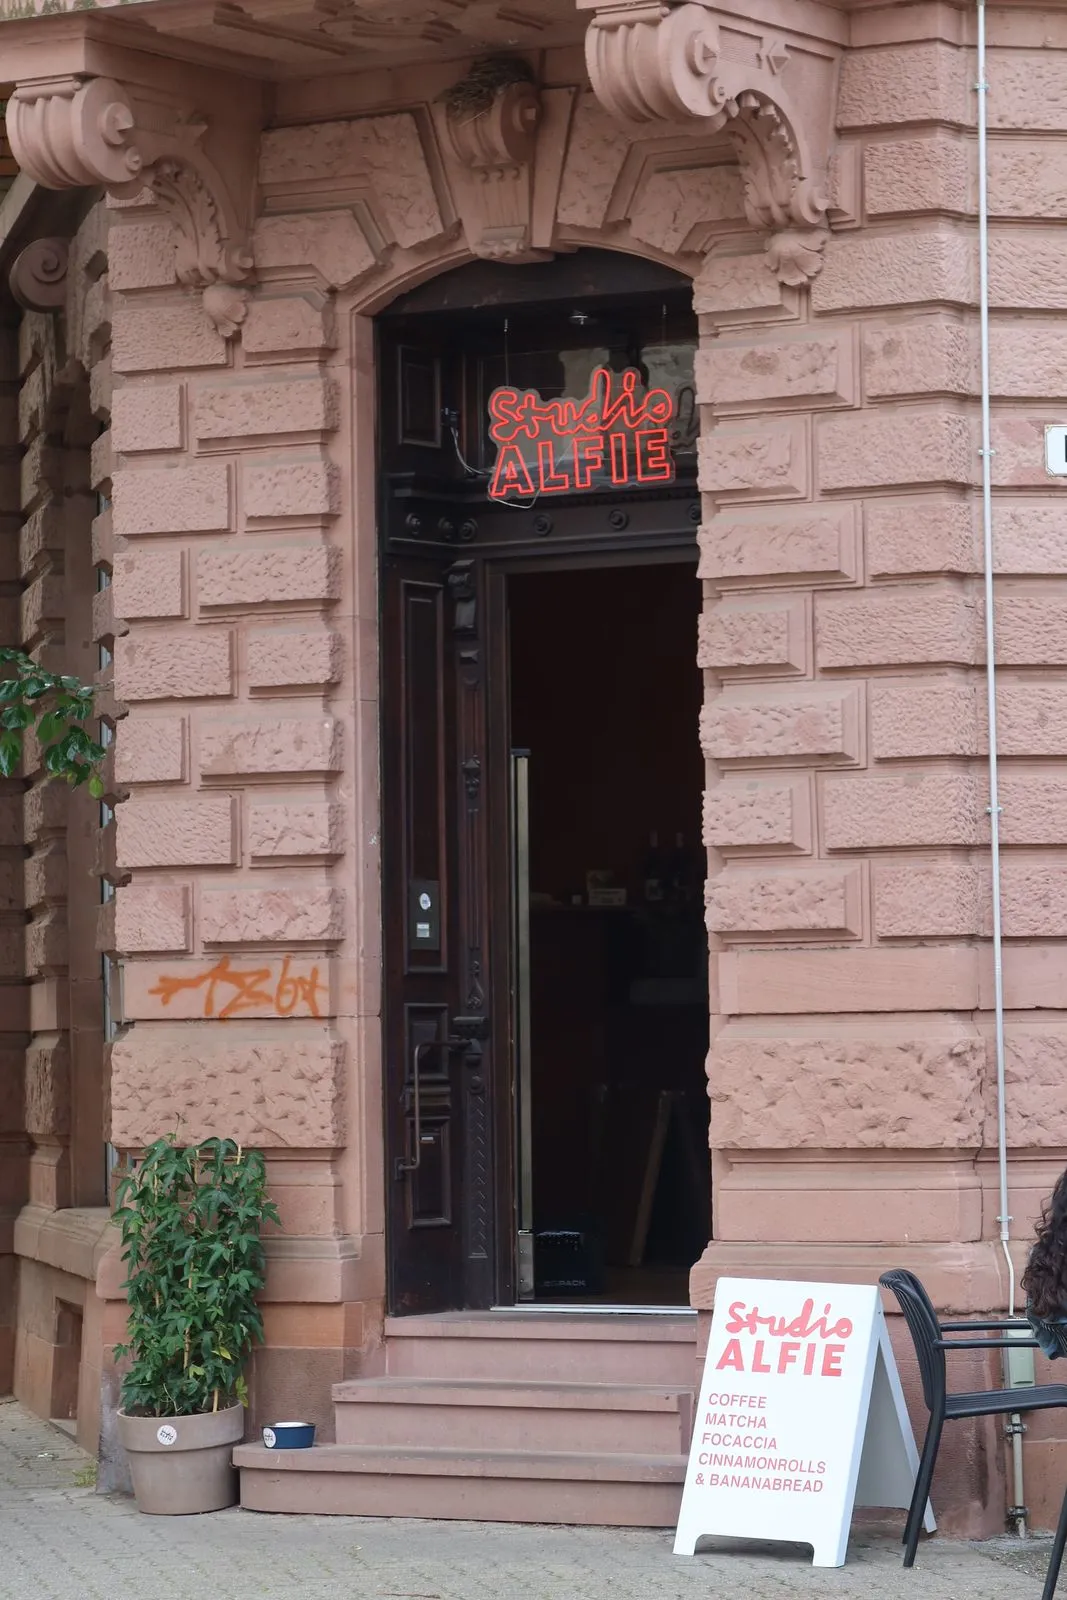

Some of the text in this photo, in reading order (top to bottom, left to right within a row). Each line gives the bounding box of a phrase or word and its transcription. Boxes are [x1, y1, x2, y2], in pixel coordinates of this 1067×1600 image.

[489, 368, 674, 442] Studio
[488, 428, 671, 498] ALFIE
[725, 1298, 853, 1339] Studio
[715, 1338, 846, 1378] ALFIE
[708, 1393, 768, 1410] COFFEE
[705, 1413, 768, 1430] MATCHA
[701, 1432, 778, 1451] FOCACCIA
[698, 1452, 827, 1475] CINNAMONROLLS
[694, 1472, 825, 1494] & BANANABREAD
